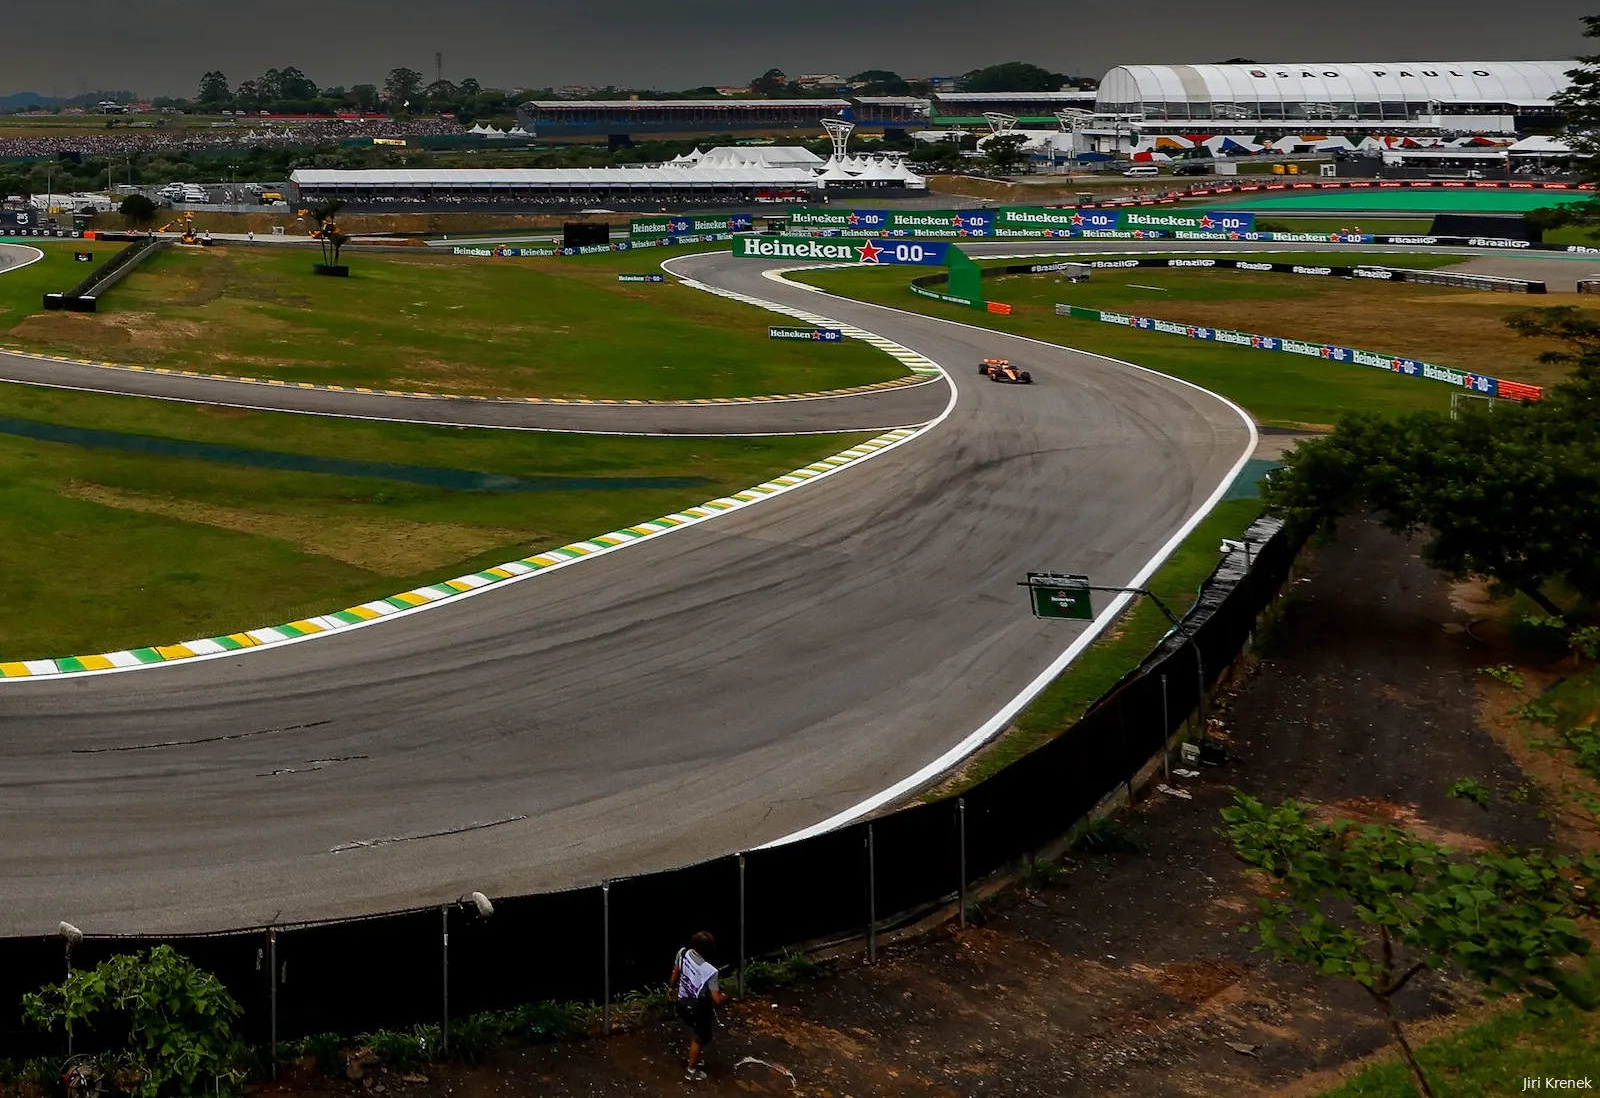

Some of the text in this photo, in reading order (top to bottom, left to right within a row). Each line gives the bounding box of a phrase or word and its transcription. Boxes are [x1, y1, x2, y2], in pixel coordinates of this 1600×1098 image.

[1373, 70, 1490, 78] PAULO
[792, 214, 846, 224] Heineken
[894, 215, 949, 226] Heineken
[1006, 212, 1068, 224] Heineken
[1128, 214, 1196, 227] Heineken
[632, 221, 666, 233] Heineken
[694, 220, 726, 230] Heineken
[914, 229, 957, 237] Heineken
[995, 229, 1041, 237] Heineken
[1082, 230, 1130, 238] Heineken
[1175, 231, 1227, 240] Heineken
[1272, 233, 1327, 242] Heineken
[1468, 239, 1531, 248] #BrazilGP
[454, 247, 490, 256] Heineken
[520, 248, 553, 256] Heineken
[580, 244, 610, 254] Heineken
[744, 239, 923, 262] Heineken 0.0
[1091, 260, 1139, 268] #BrazilGP
[1168, 259, 1215, 267] #BrazilGP
[1100, 311, 1130, 326] Heineken
[1154, 320, 1187, 335] Heineken
[770, 330, 810, 338] Heineken
[1215, 329, 1251, 346] Heineken
[1281, 339, 1320, 357] Heineken
[1352, 351, 1390, 369] Heineken
[1423, 364, 1463, 385] Heineken
